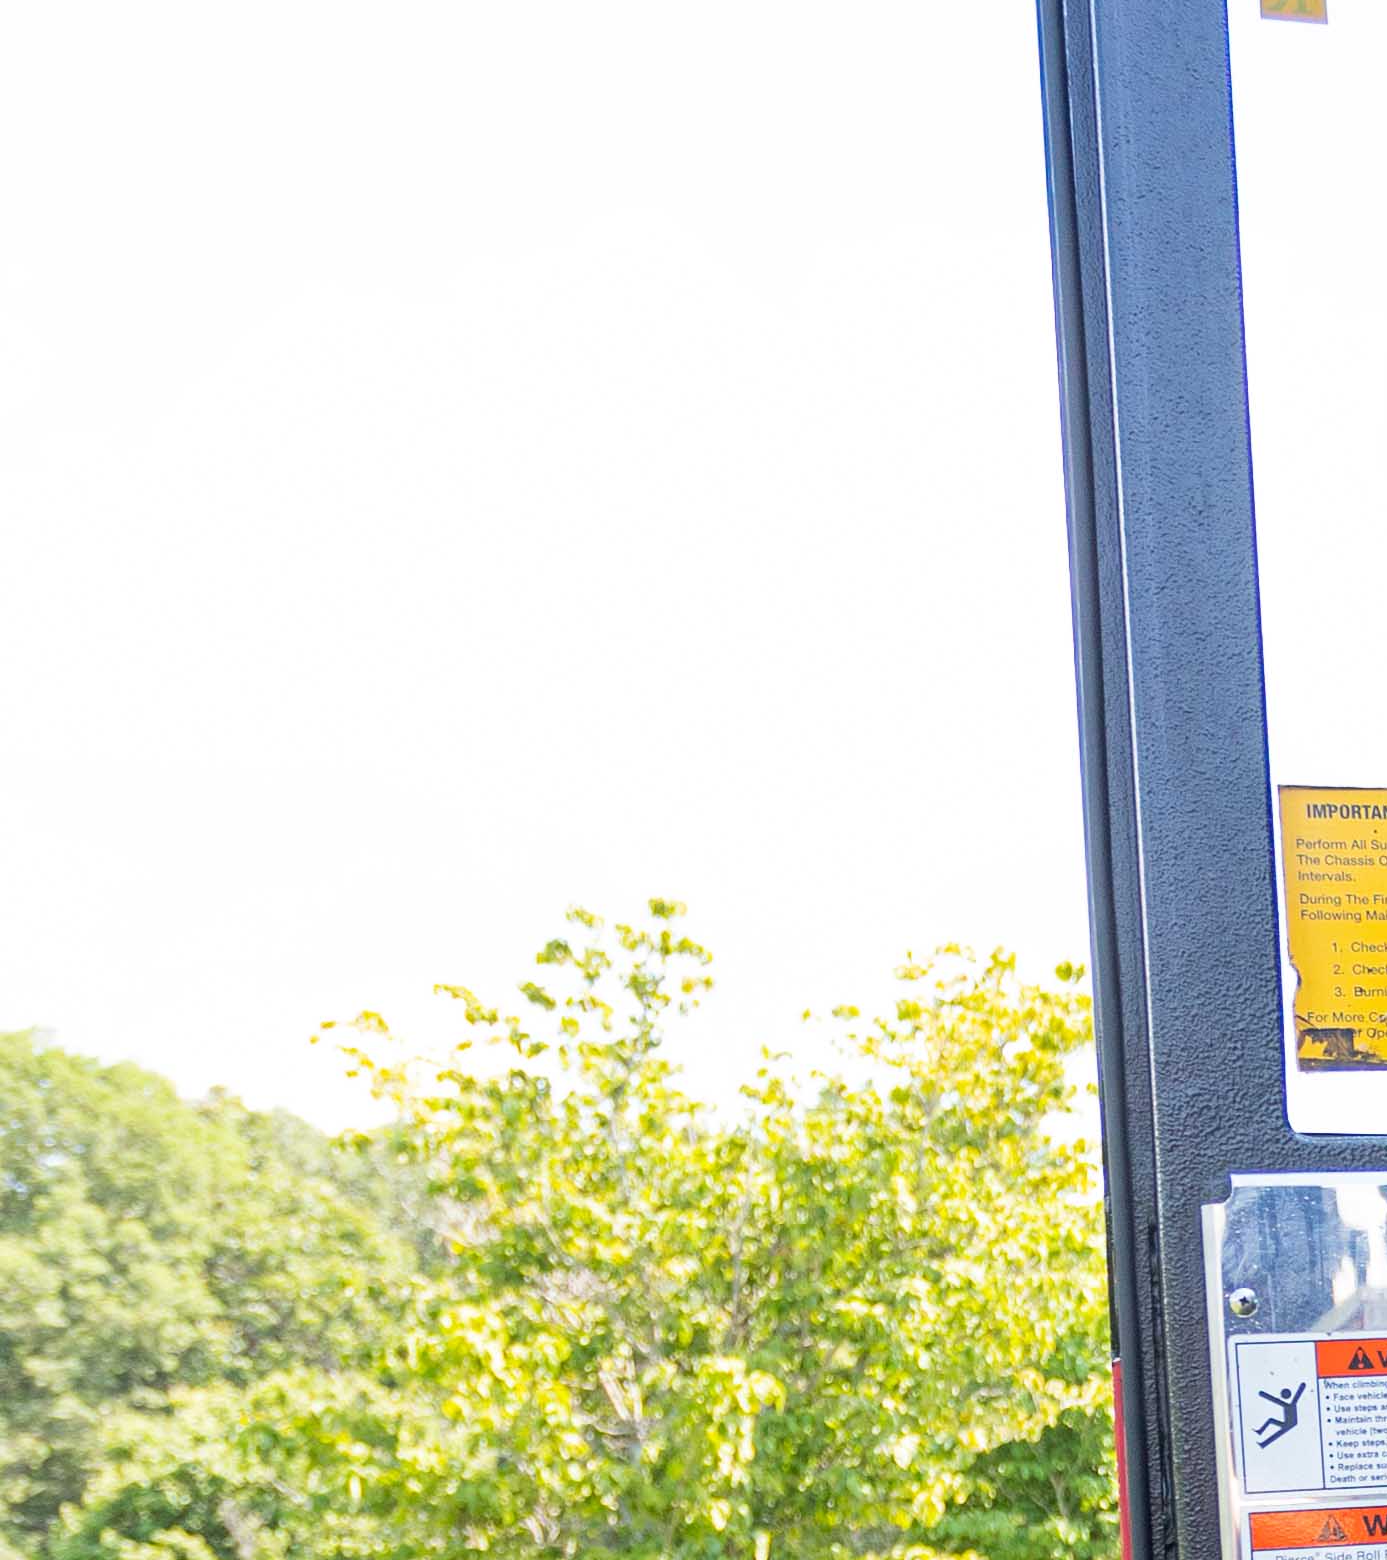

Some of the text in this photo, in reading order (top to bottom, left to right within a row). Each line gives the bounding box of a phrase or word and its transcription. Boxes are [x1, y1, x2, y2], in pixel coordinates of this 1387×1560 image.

[1295, 838, 1347, 849] Perform
[1351, 839, 1367, 849] All
[1295, 853, 1320, 865] The
[1324, 854, 1375, 865] Chassis
[1297, 870, 1356, 882] Intervals.
[1299, 893, 1341, 906] During
[1345, 893, 1372, 904] The
[1300, 909, 1362, 923] Following
[1332, 943, 1342, 953] 1.
[1323, 1378, 1349, 1389] When
[1333, 1391, 1387, 1400] Face vehicle.
[1356, 1550, 1380, 1560] Roll
